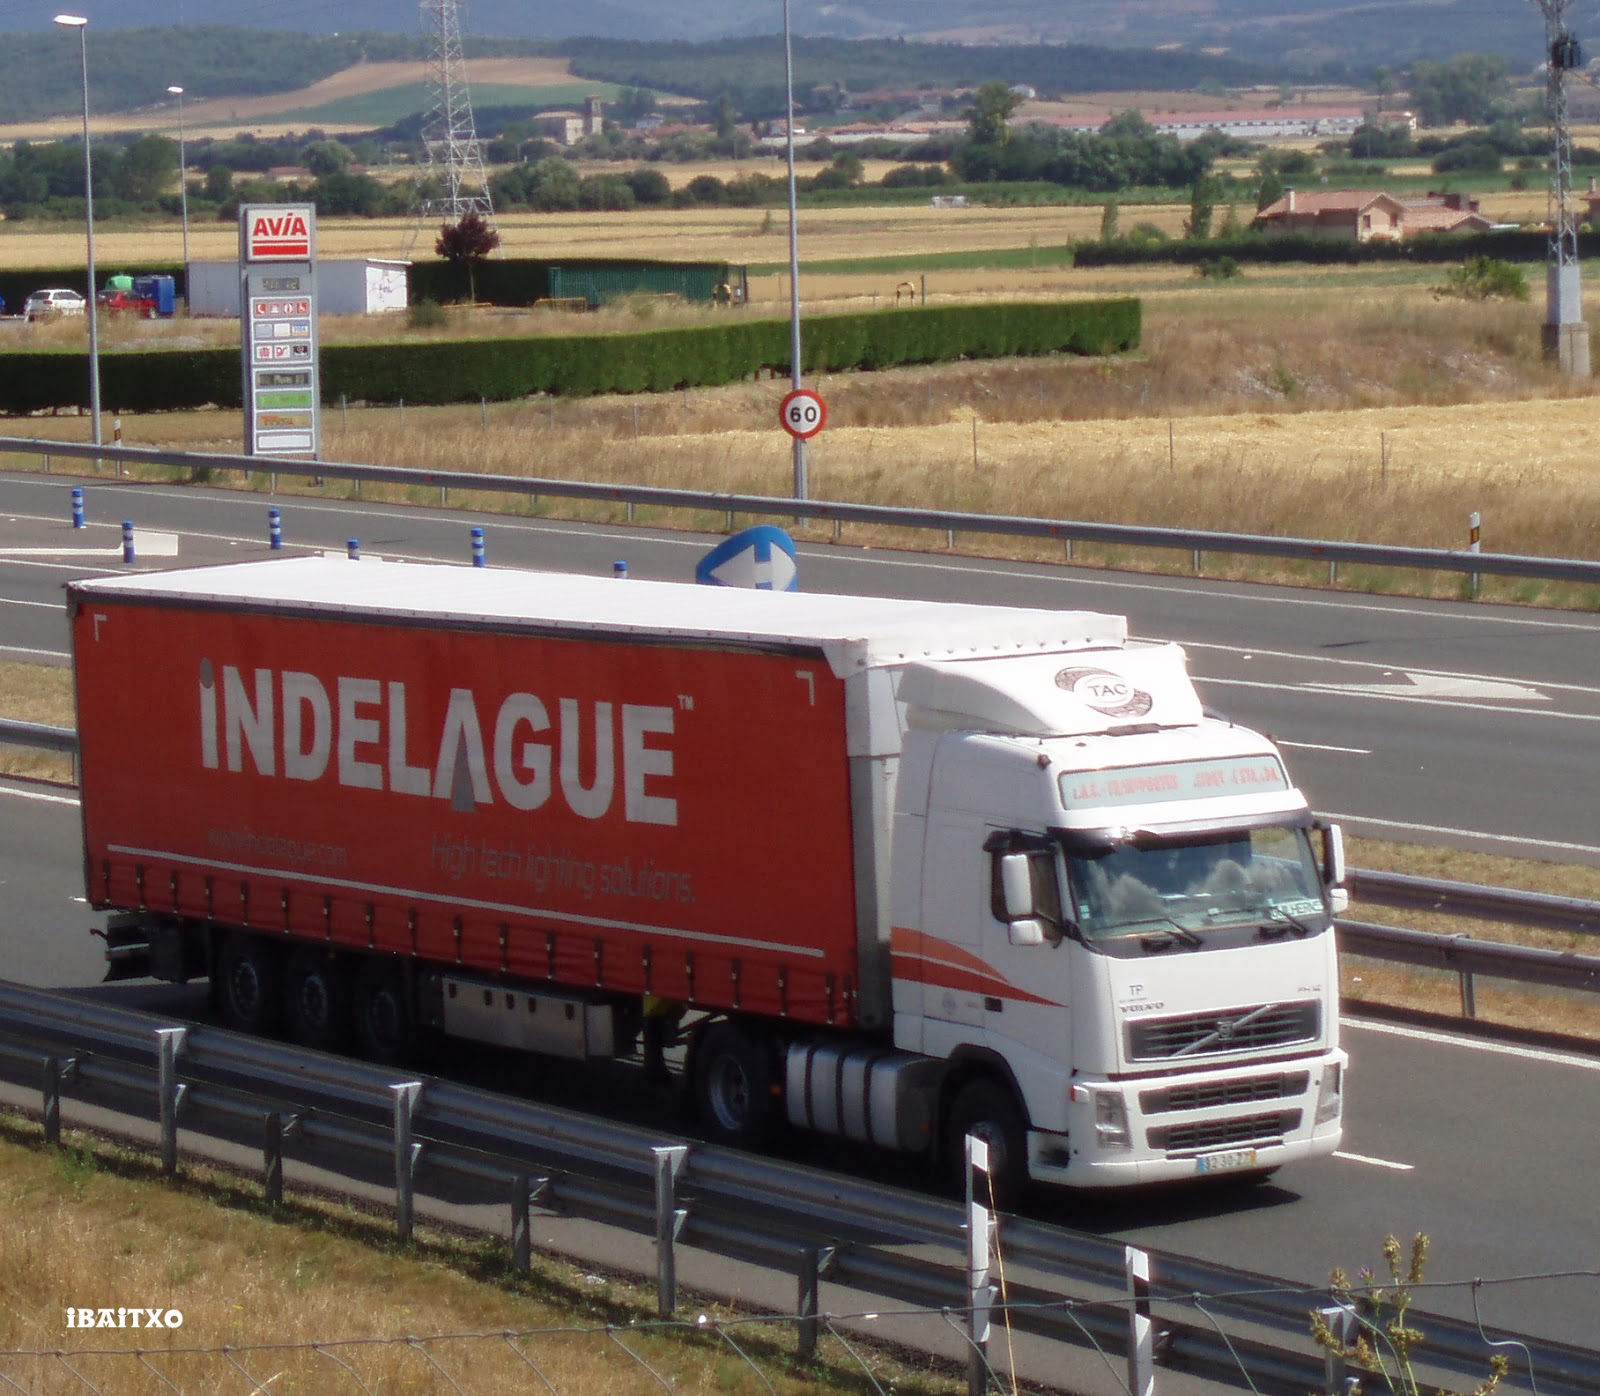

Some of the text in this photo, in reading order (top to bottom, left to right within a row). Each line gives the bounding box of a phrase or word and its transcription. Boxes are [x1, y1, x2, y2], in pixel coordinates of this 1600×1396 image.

[790, 406, 817, 423] 60
[1087, 683, 1128, 697] TAC
[199, 656, 678, 827] INDELAGUE
[431, 831, 476, 880] High
[1129, 984, 1143, 996] TP
[1119, 1002, 1165, 1014] VOLVO
